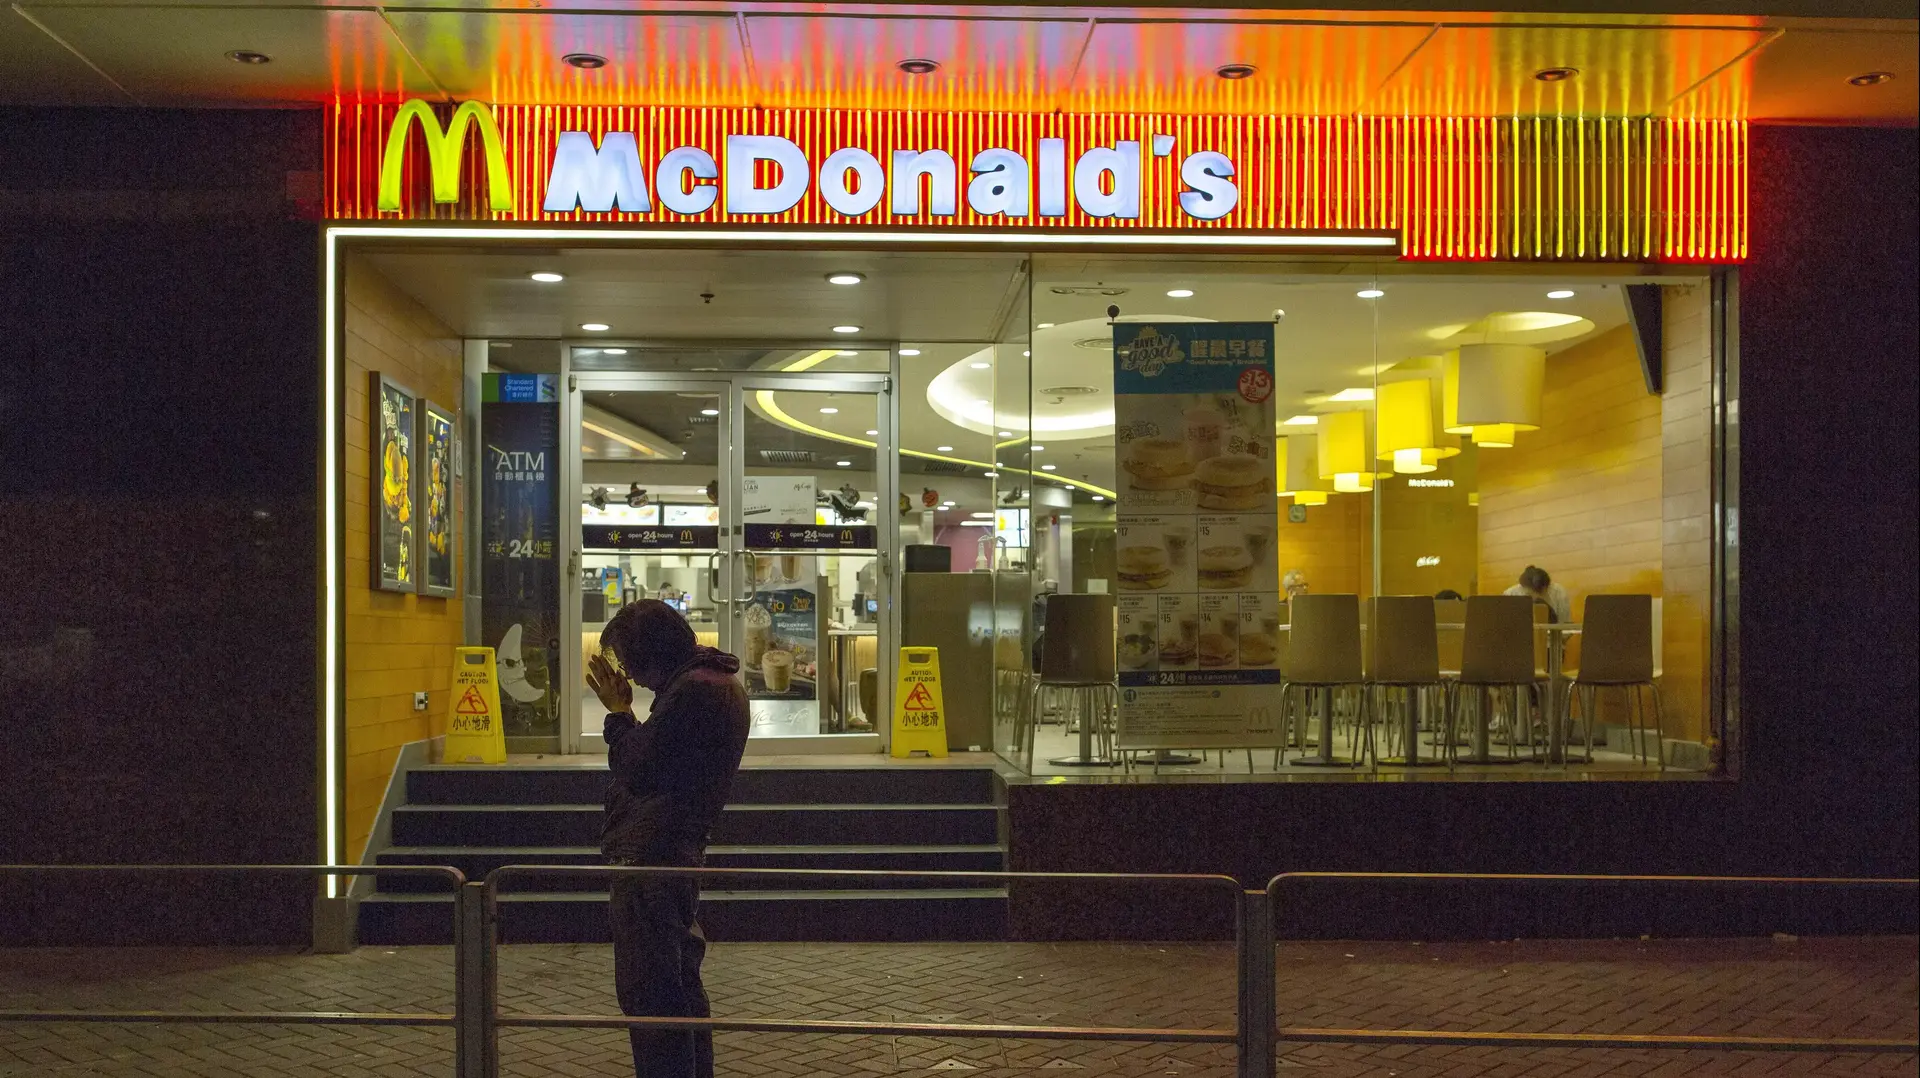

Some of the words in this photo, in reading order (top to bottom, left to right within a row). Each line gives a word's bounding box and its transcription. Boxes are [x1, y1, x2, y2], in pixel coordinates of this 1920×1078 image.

[543, 130, 1239, 219] McDonald's
[1134, 336, 1155, 349] HAVE
[1127, 335, 1175, 369] good
[496, 451, 545, 471] ATM
[1408, 479, 1454, 487] McDonald's
[643, 530, 657, 540] 24
[657, 531, 674, 539] hours
[789, 531, 804, 539] open
[804, 530, 818, 539] 24
[818, 531, 834, 539] hours
[509, 539, 534, 558] 24
[1160, 672, 1174, 685] 24
[452, 715, 491, 731] 小心地滑
[902, 711, 939, 727] 小心地滑
